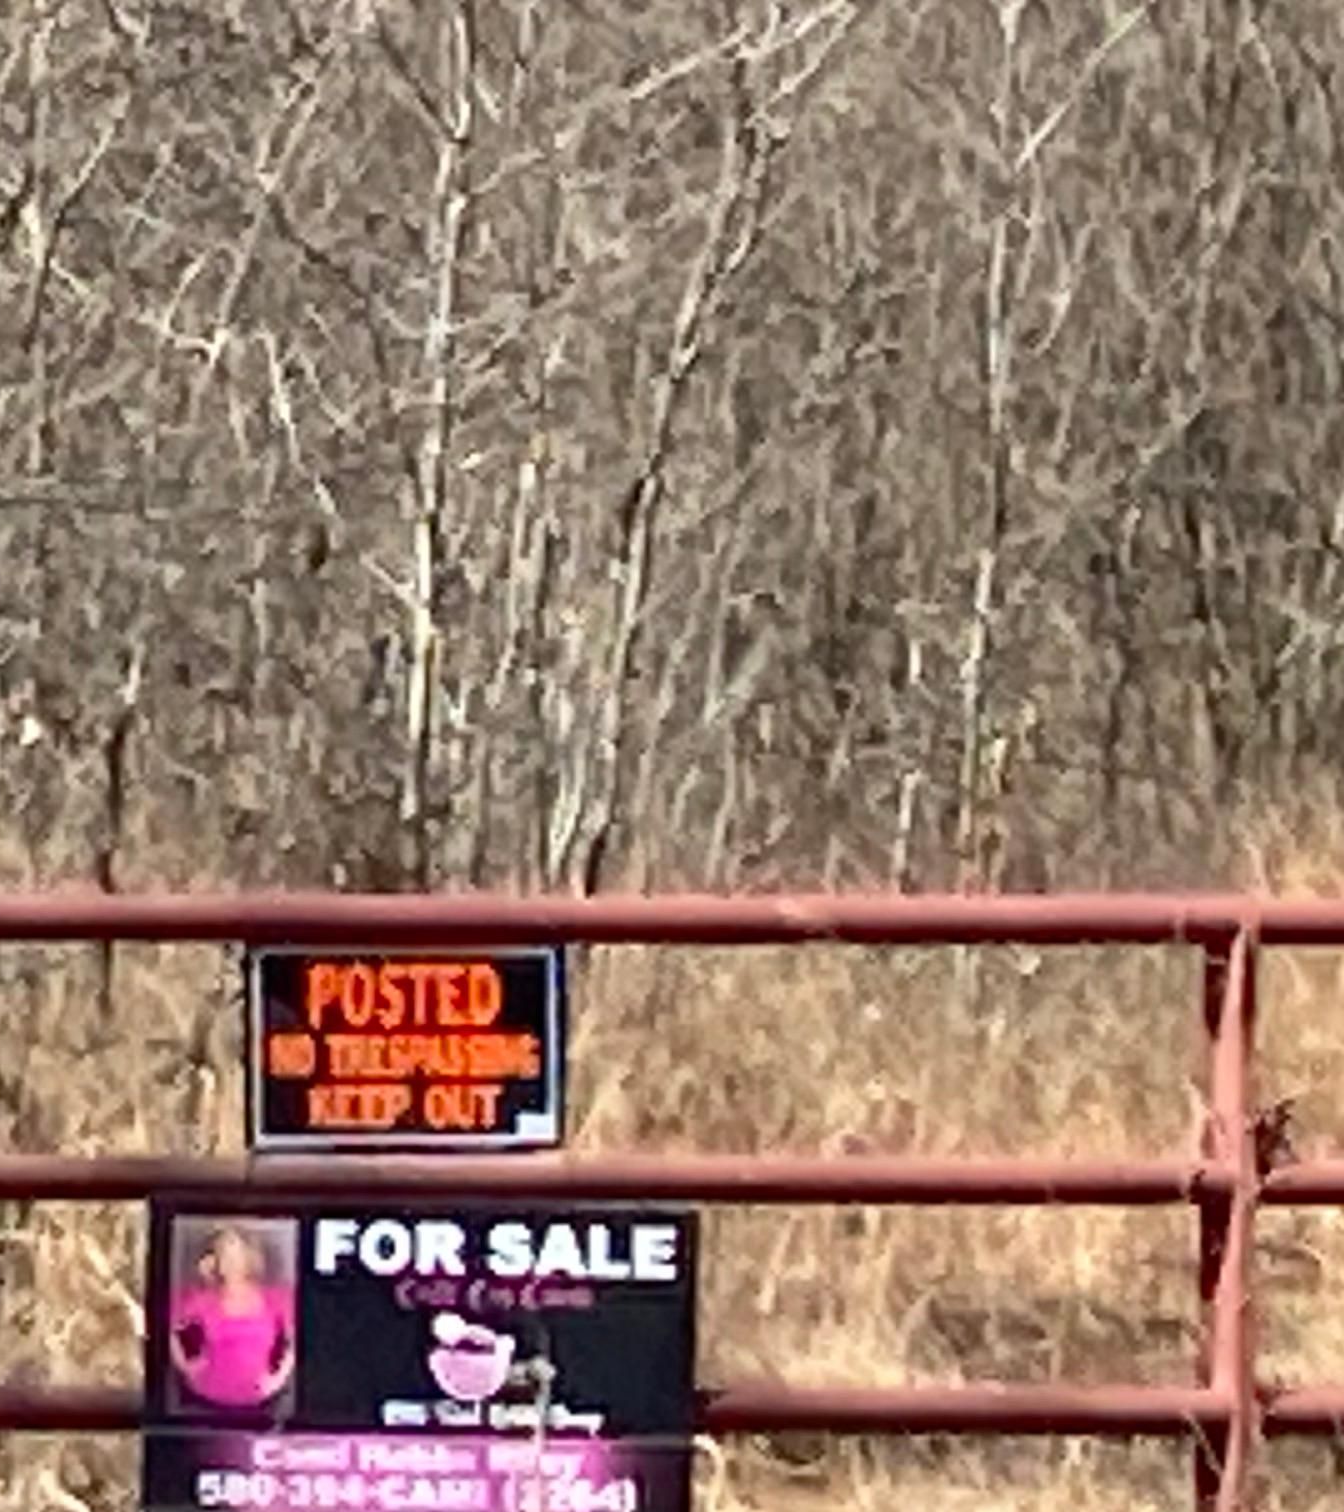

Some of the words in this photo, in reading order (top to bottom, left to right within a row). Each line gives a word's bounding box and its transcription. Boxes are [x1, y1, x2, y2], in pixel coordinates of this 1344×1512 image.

[309, 963, 501, 1028] POSTED
[269, 1034, 315, 1079] NO
[325, 1034, 540, 1080] TRESPASSING
[309, 1084, 411, 1128] KEEP
[424, 1084, 503, 1129] OUT
[314, 1218, 466, 1276] FOR
[487, 1222, 677, 1281] SALE
